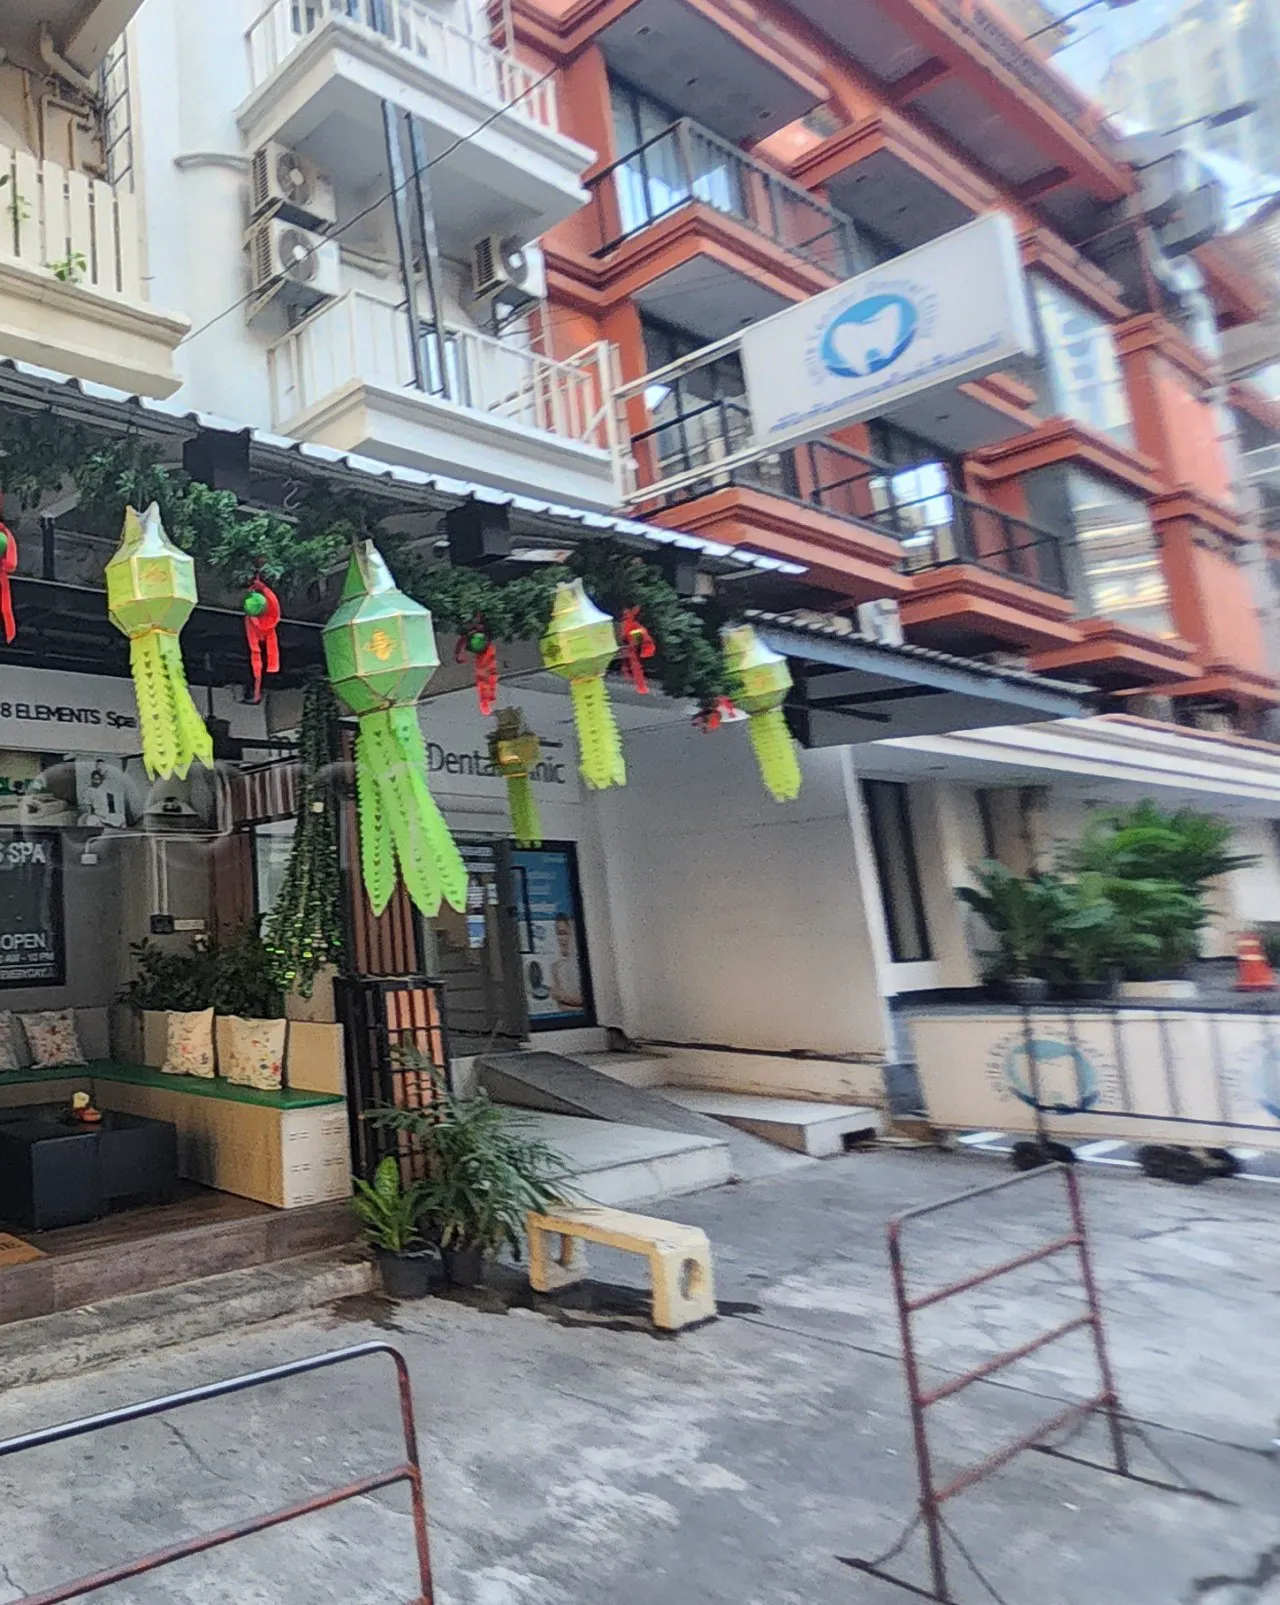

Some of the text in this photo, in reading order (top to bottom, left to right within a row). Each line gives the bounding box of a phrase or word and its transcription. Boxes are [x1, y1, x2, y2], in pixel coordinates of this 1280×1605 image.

[0, 702, 13, 719] 8
[15, 703, 102, 725] ELEMENTS
[426, 741, 506, 777] Denta
[8, 841, 47, 864] SPA
[0, 932, 46, 951] OPEN
